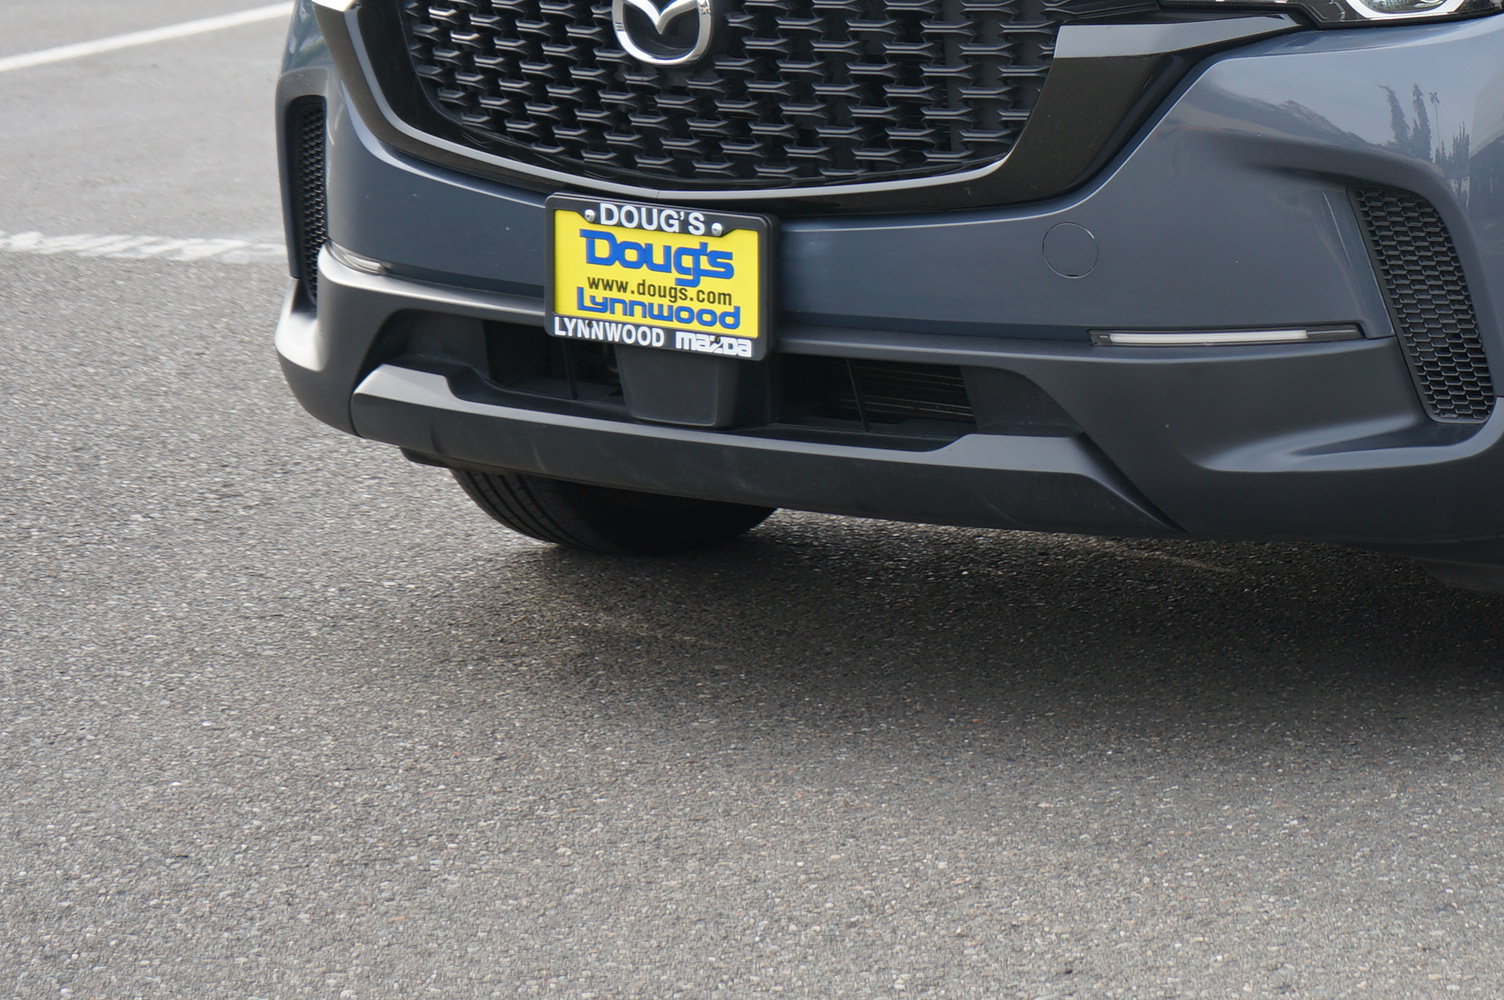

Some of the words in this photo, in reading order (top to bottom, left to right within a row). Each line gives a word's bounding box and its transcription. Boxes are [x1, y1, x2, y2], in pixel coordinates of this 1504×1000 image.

[600, 203, 705, 235] DOUG'S
[579, 229, 735, 288] Doug's
[587, 276, 732, 306] www.dougs.com
[576, 287, 741, 329] Lynnwood
[554, 317, 665, 347] LYNNWOOD
